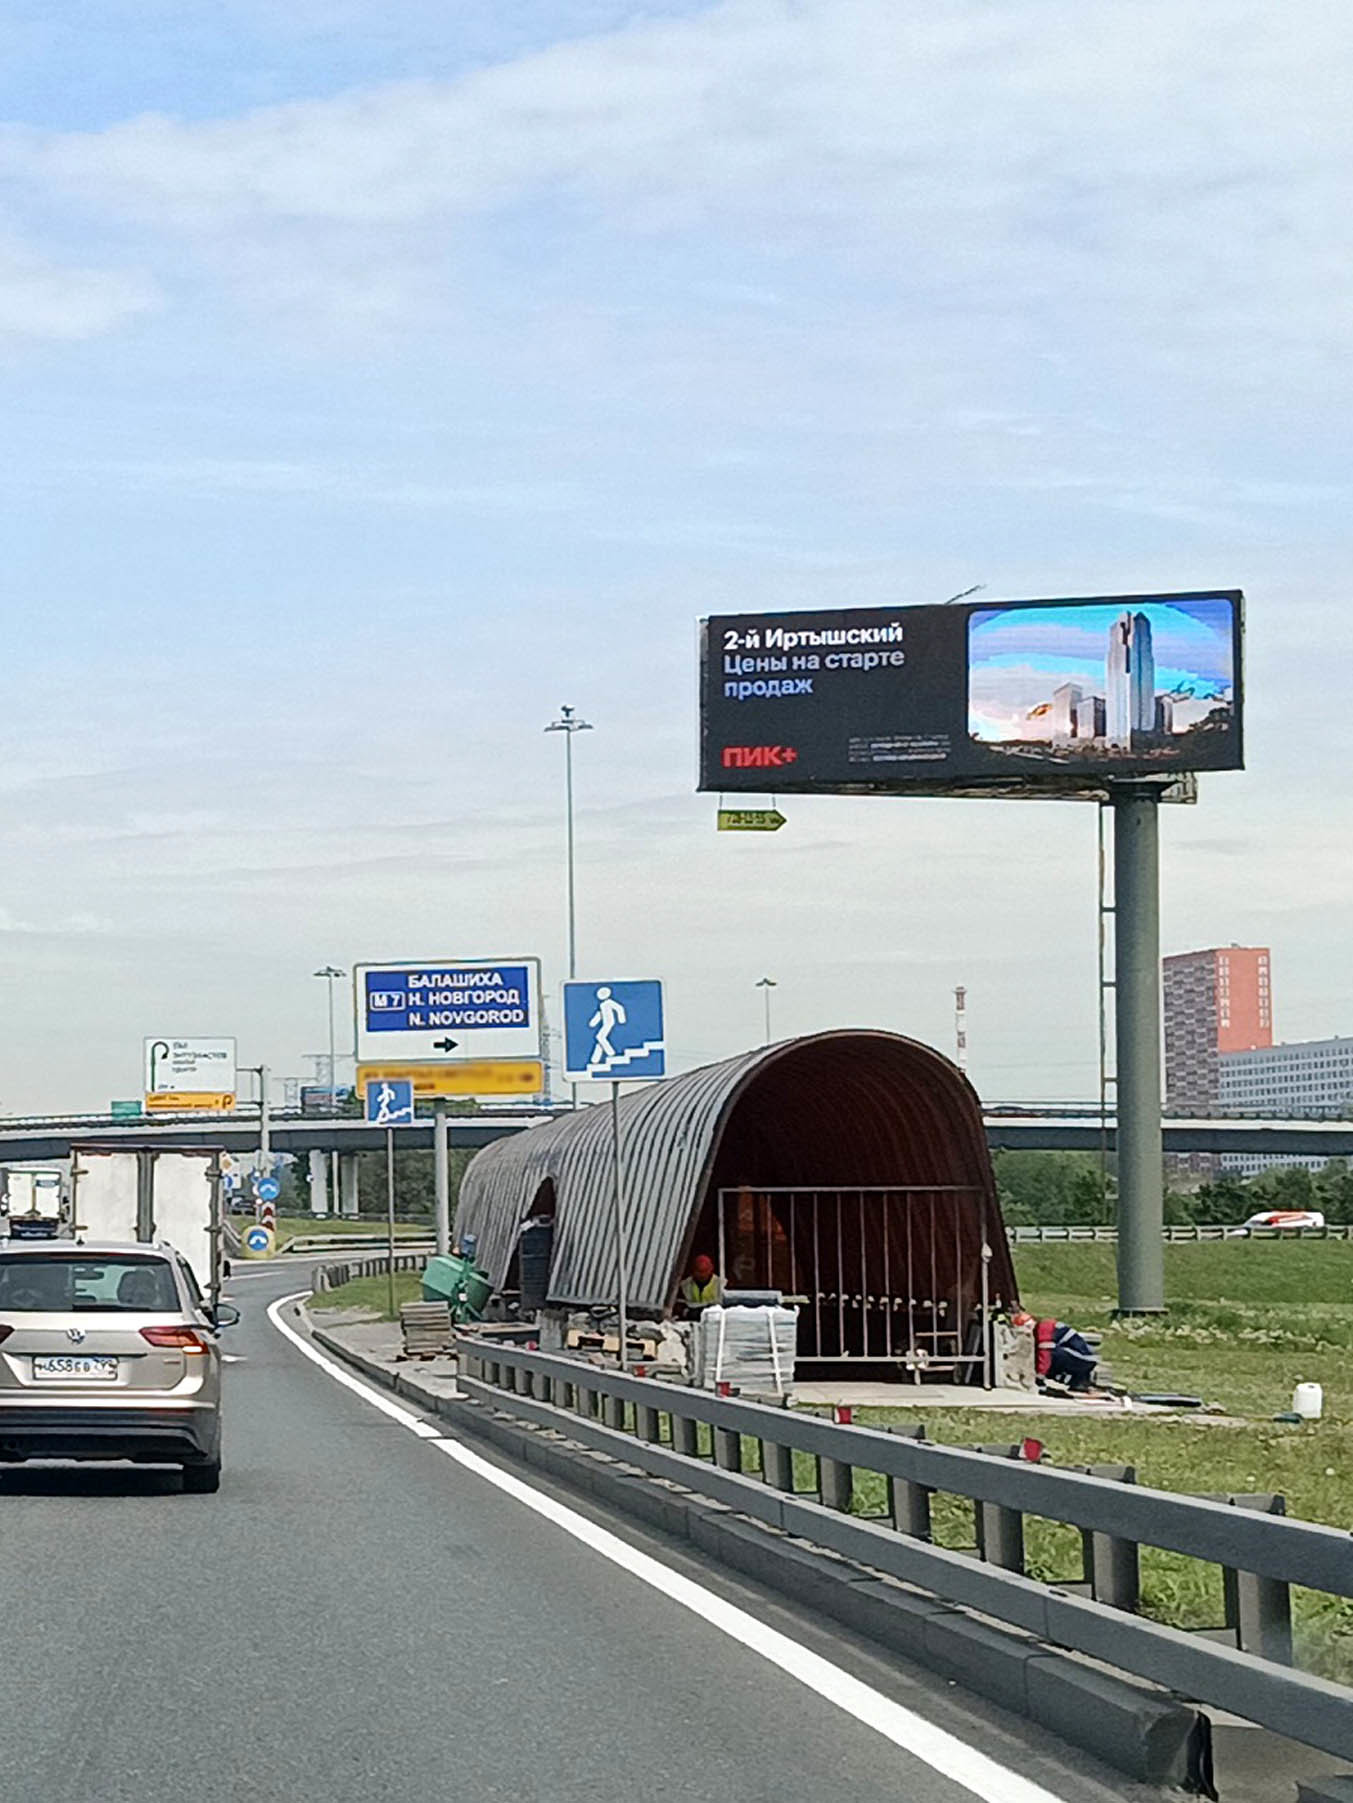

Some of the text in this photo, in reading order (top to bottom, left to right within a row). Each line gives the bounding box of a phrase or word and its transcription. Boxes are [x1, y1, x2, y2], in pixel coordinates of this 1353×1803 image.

[723, 622, 903, 651] 2-й Иртышский
[724, 650, 905, 675] Цены на старте
[724, 678, 813, 700] продаж
[723, 746, 797, 767] ПИК+
[408, 972, 503, 988] БАЛАШИХА
[408, 988, 520, 1006] Н. НОВГОРОД
[409, 1009, 524, 1026] N. NOVGOROD
